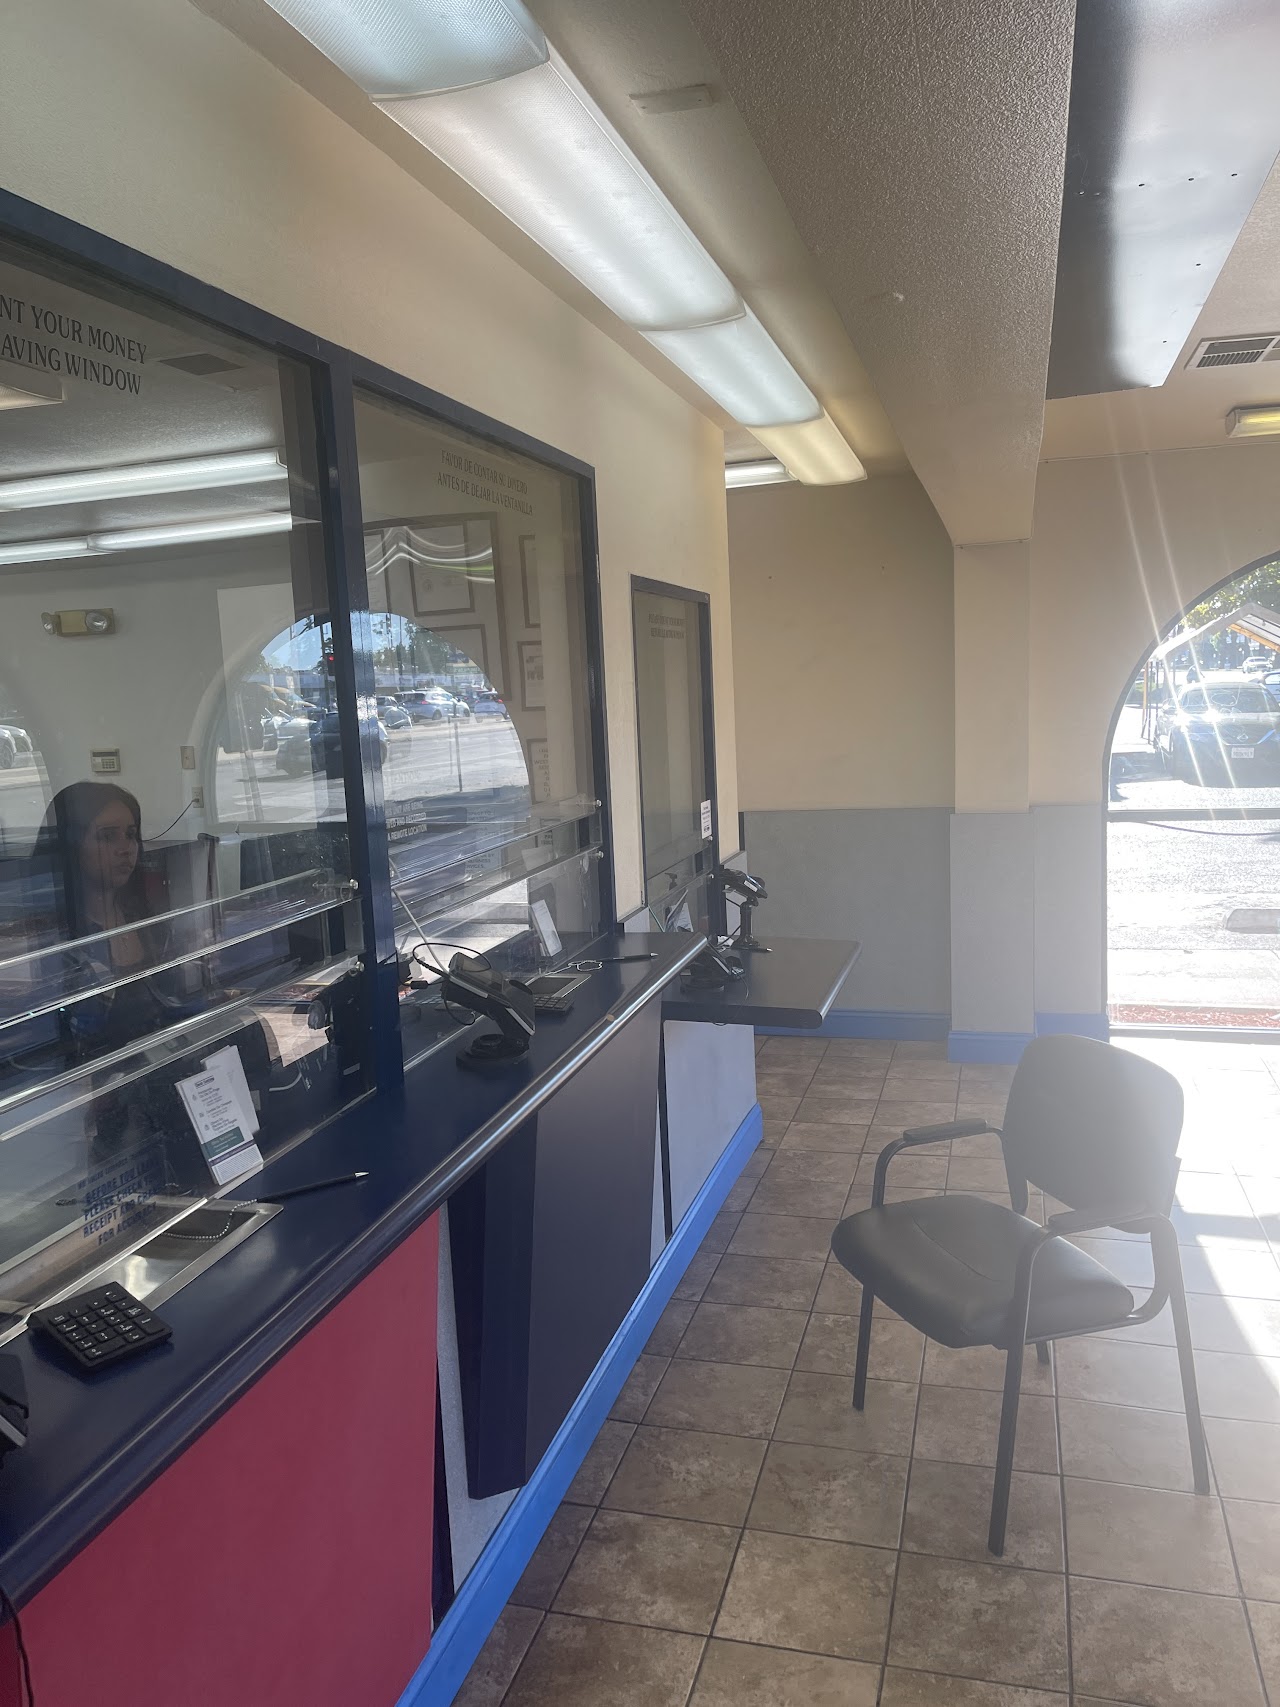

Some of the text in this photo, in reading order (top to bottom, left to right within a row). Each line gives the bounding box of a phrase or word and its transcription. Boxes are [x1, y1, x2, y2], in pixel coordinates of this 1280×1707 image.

[31, 305, 83, 343] YOUR
[88, 325, 147, 364] MONEY
[2, 333, 141, 394] AVING WINDOW
[441, 450, 463, 470] FAVOR
[464, 459, 473, 474] DE
[437, 472, 460, 491] ANTES
[461, 480, 470, 494] DE
[471, 484, 491, 501] DEJAR
[83, 1209, 117, 1238] RECEIPT
[98, 1228, 115, 1246] FOR
